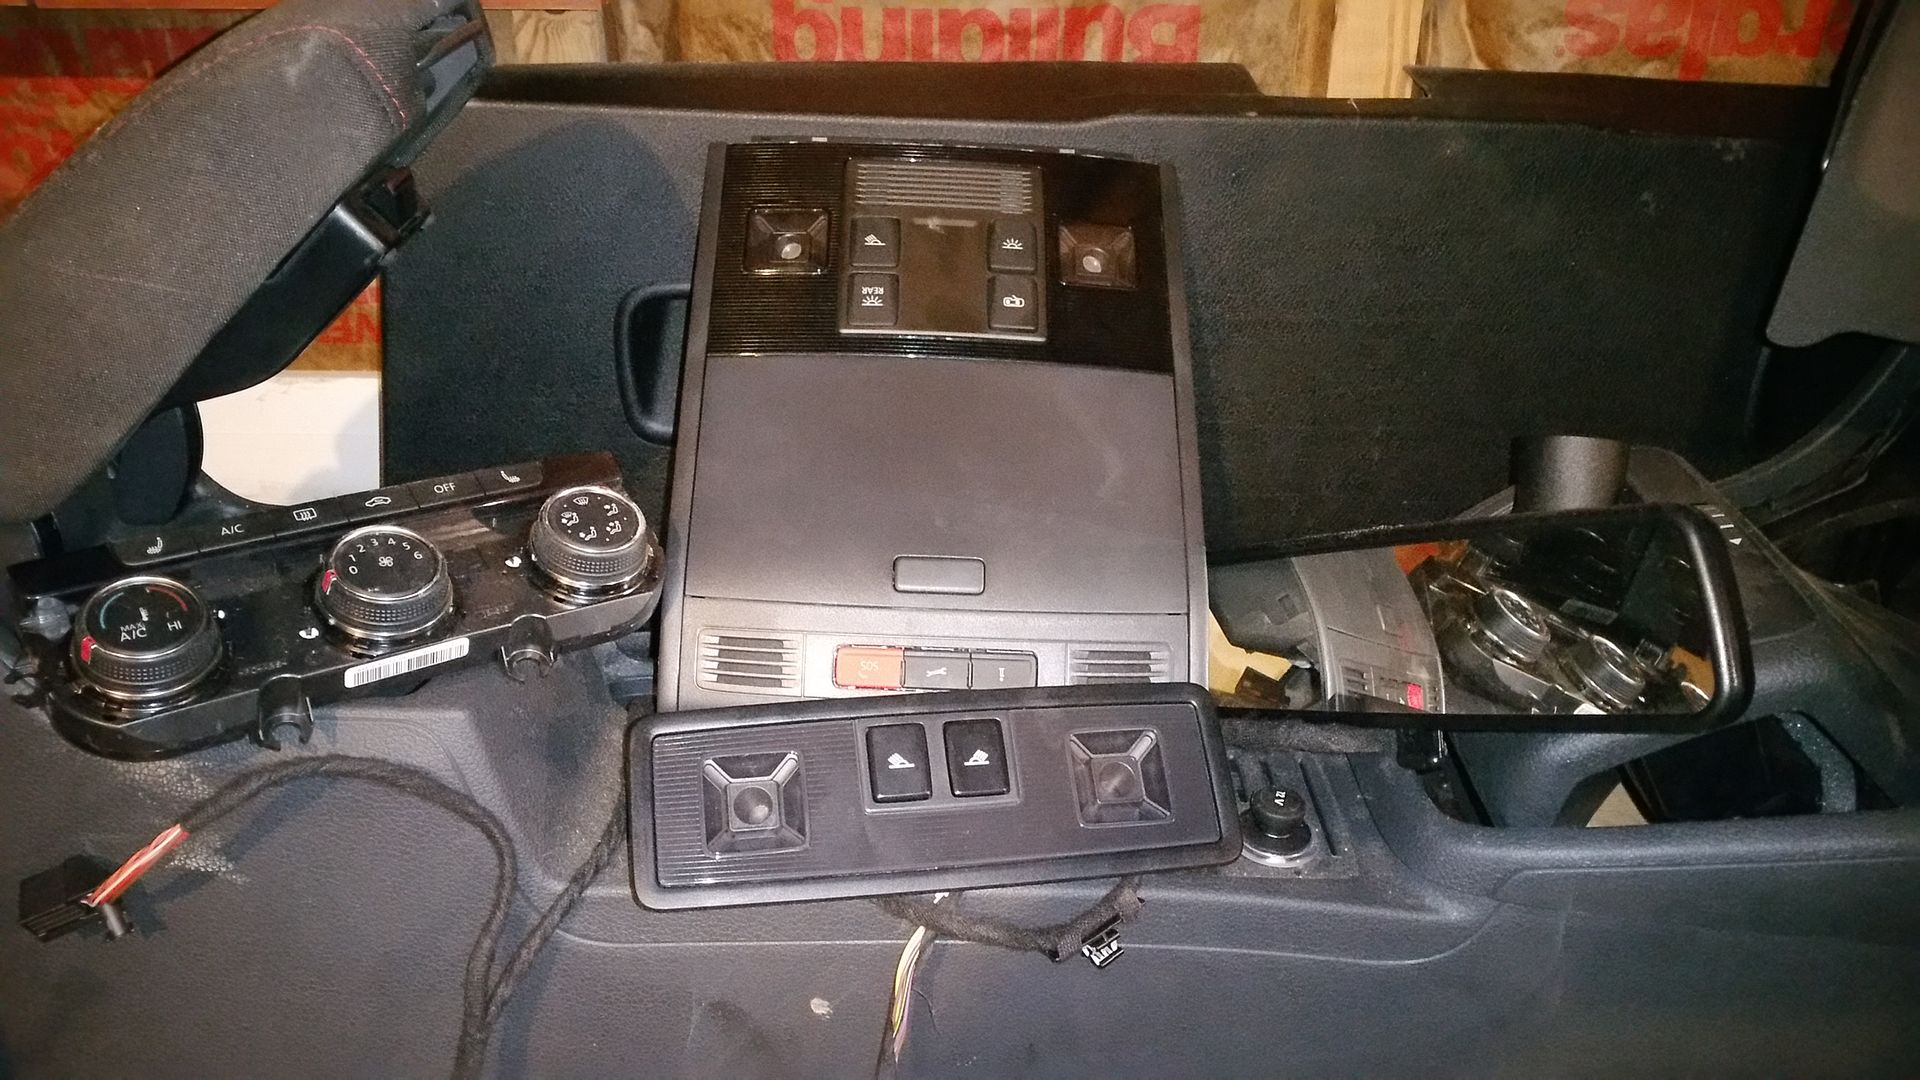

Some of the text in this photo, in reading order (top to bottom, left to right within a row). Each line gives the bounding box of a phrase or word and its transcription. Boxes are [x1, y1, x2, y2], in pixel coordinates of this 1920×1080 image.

[861, 286, 884, 295] REAR
[433, 482, 456, 494] OFF
[221, 523, 245, 536] A/C
[119, 622, 145, 632] MAX
[167, 620, 183, 632] HI
[120, 628, 148, 642] A/C
[860, 660, 880, 672] SOS
